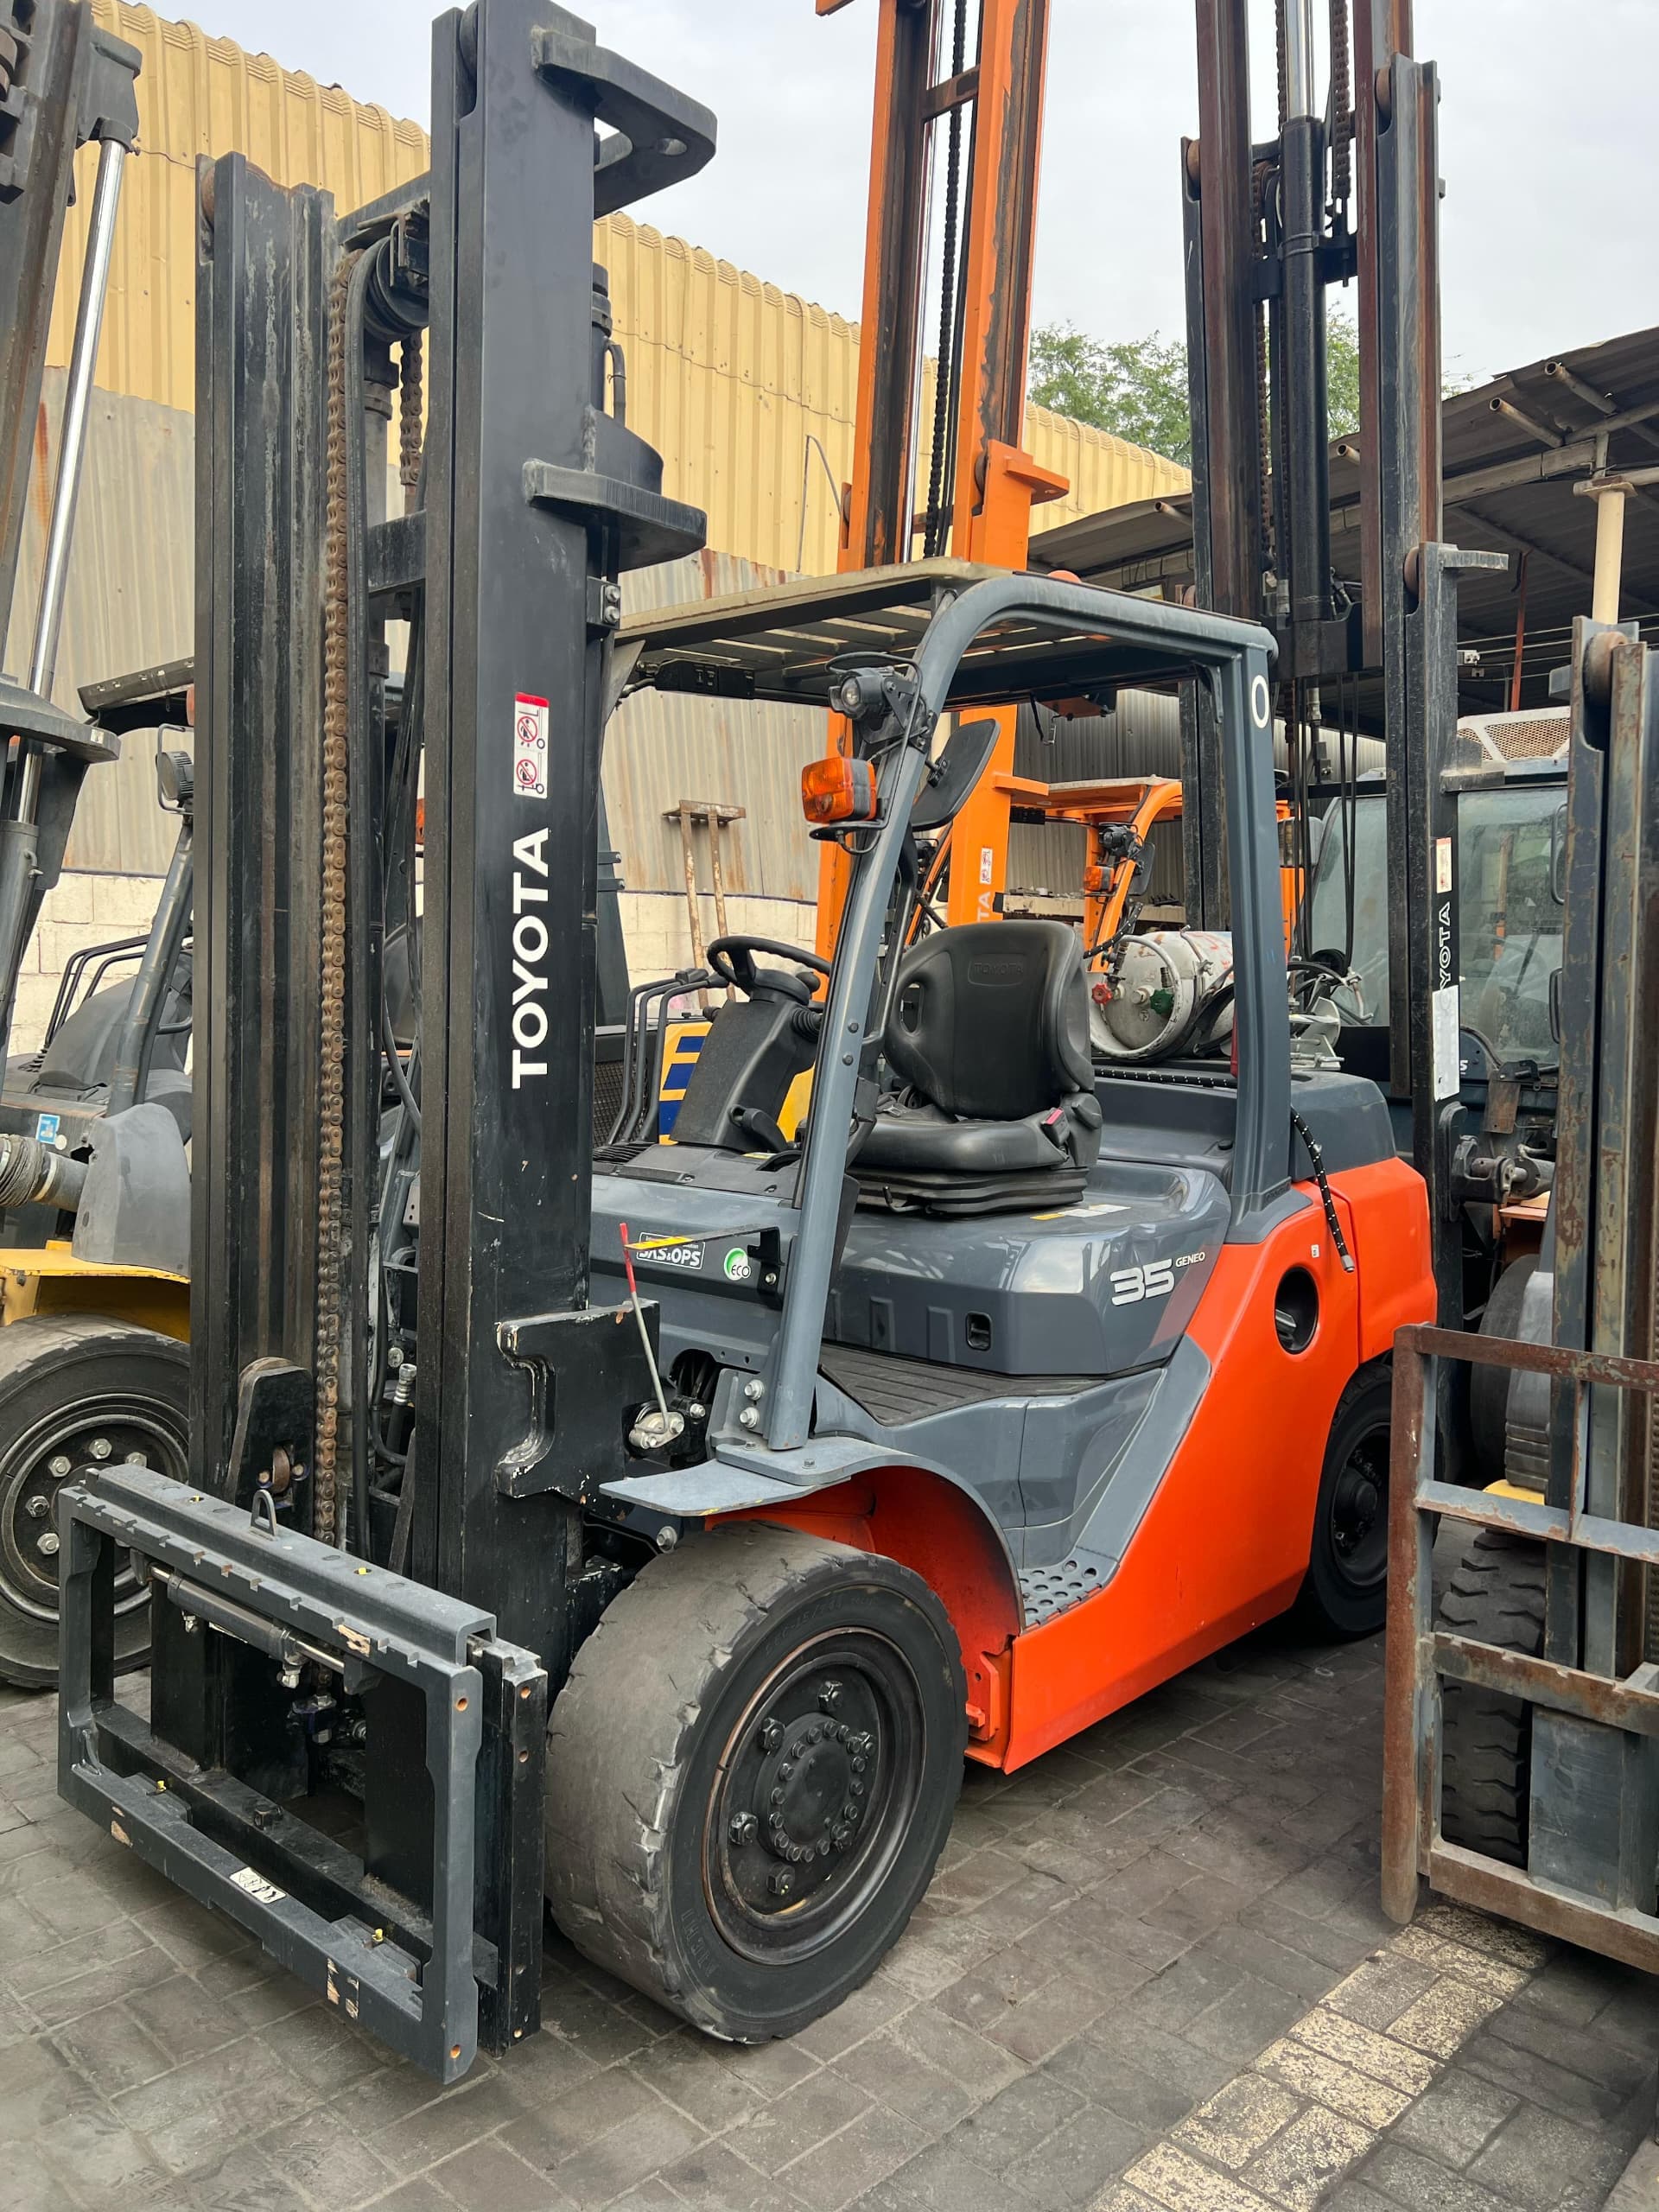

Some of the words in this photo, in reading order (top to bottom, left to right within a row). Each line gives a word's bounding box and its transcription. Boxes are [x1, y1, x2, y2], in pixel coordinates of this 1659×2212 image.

[512, 828, 549, 1089] TOYOTA
[1439, 901, 1452, 992] YOTA
[731, 1264, 751, 1278] ECO
[1109, 1258, 1175, 1306] 35
[1175, 1251, 1206, 1268] GENEO
